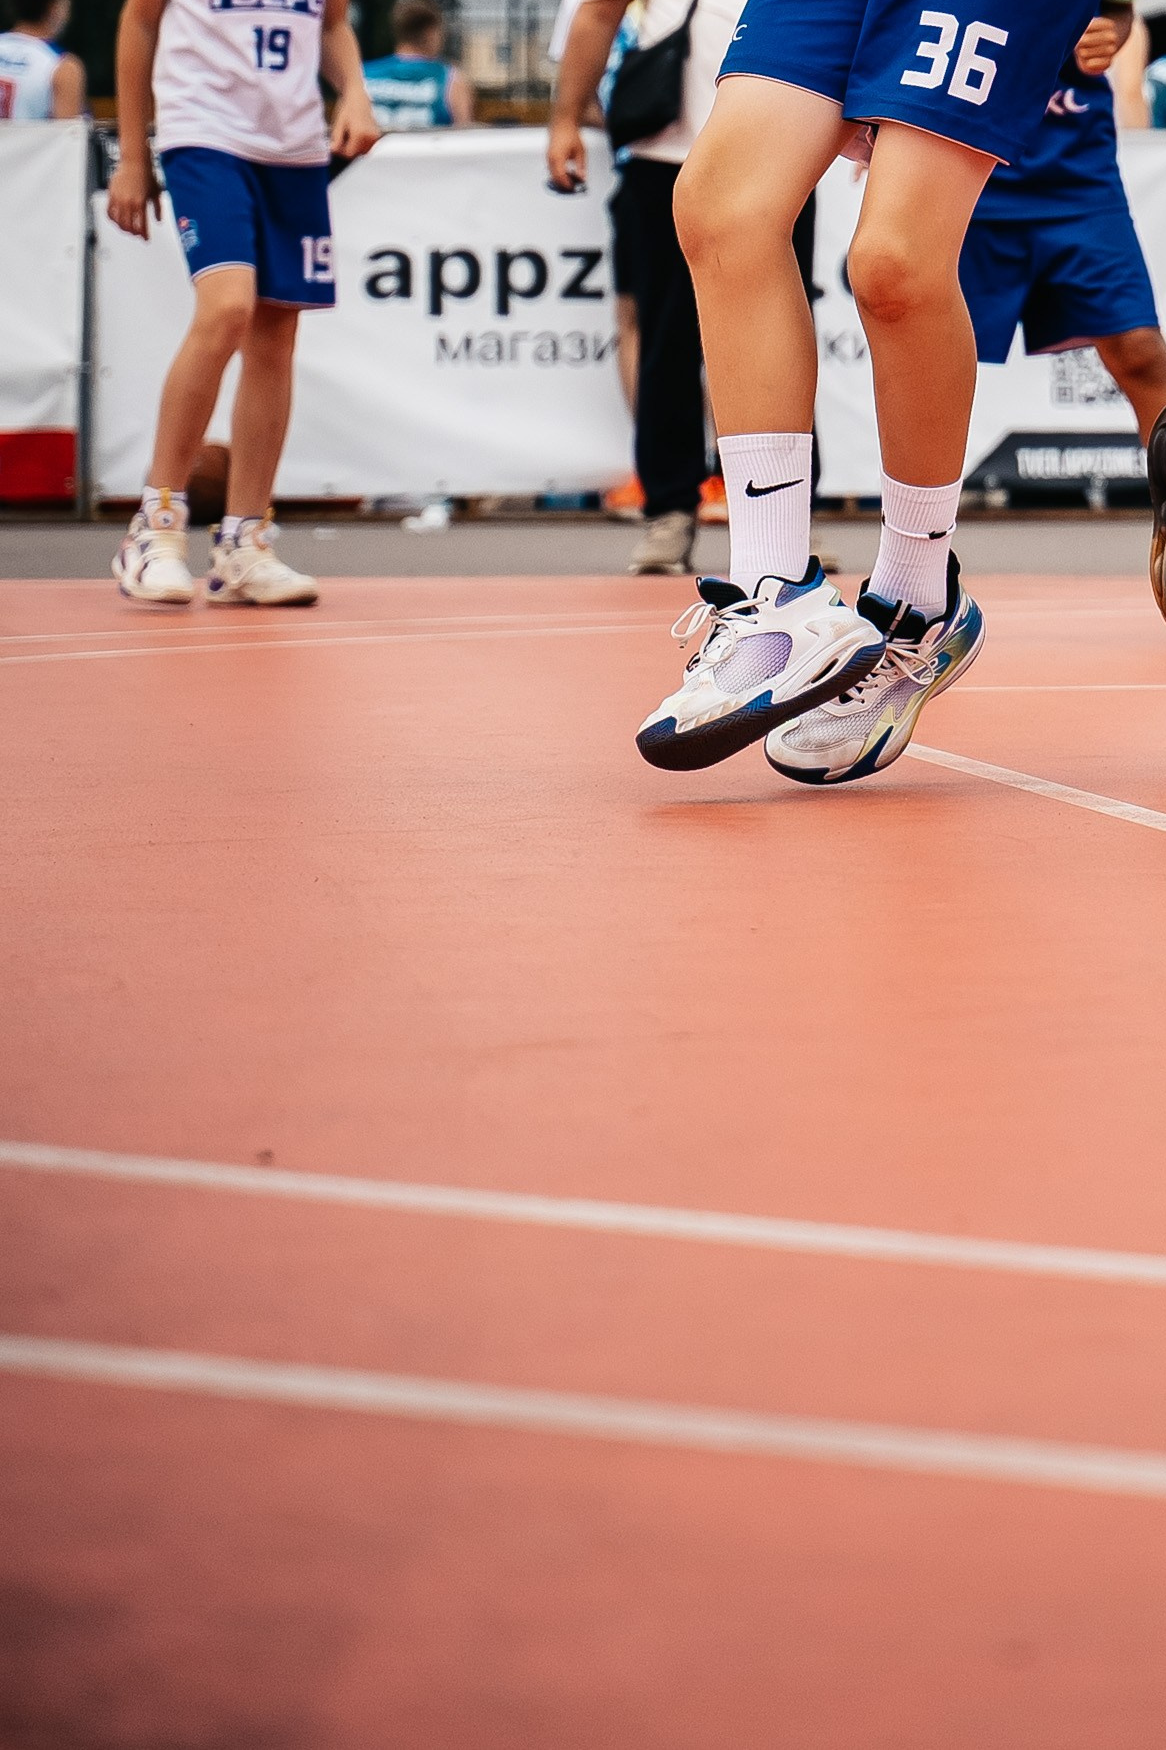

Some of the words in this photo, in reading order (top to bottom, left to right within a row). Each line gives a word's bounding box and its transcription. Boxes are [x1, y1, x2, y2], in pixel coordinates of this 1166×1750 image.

[253, 26, 291, 71] 19
[900, 10, 1009, 106] 36
[300, 235, 336, 284] 19
[436, 330, 620, 363] магази
